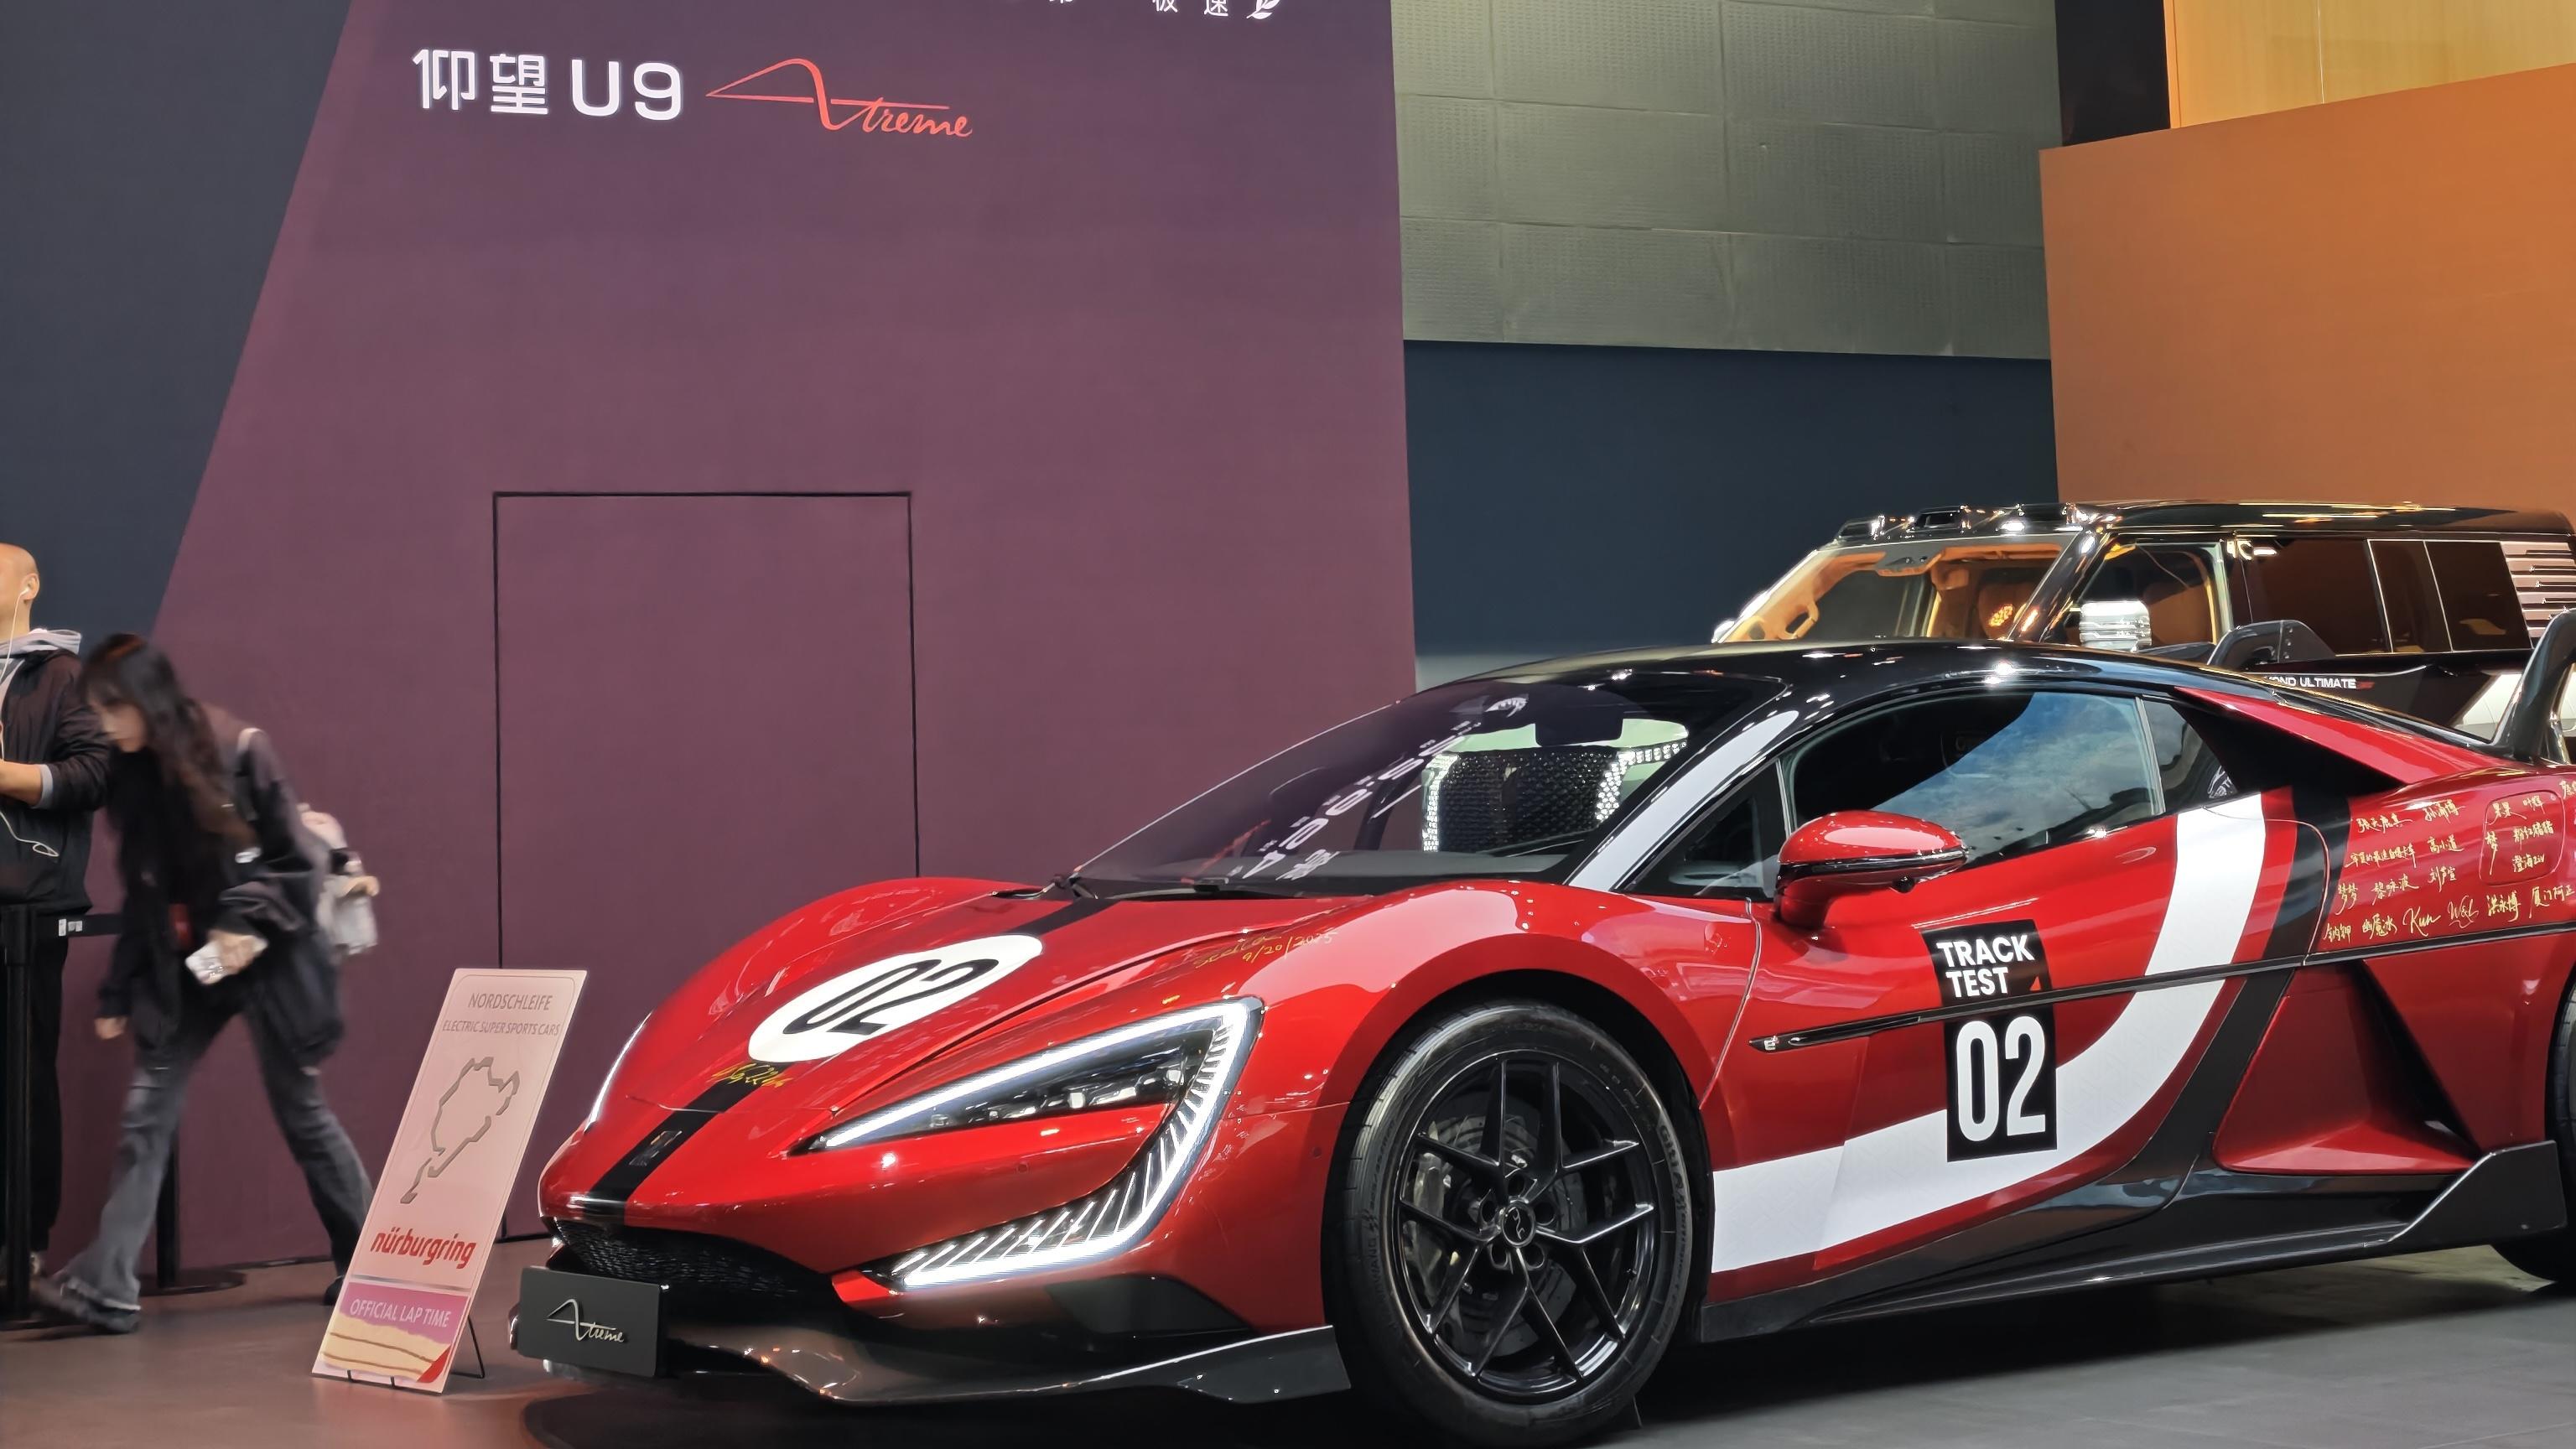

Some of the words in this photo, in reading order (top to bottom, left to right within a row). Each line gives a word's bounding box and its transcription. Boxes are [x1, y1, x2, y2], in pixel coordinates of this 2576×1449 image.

[412, 48, 549, 115] 仰望
[570, 58, 683, 121] U9
[2299, 677, 2357, 689] ULTIMATE
[1935, 934, 2036, 968] TRACK
[782, 958, 1000, 1036] 02
[1945, 966, 2009, 998] TEST
[467, 992, 553, 1011] NORDSCHLEIFE
[442, 1019, 480, 1033] ELECTRIC
[479, 1021, 506, 1034] SUPER
[505, 1022, 538, 1036] SPORTS
[538, 1024, 561, 1036] CARS
[1955, 1015, 2046, 1142] 02
[370, 1227, 477, 1270] nürburgring
[350, 1299, 398, 1322] OFFICIAL
[399, 1304, 423, 1324] LAP
[423, 1308, 452, 1328] TIME
